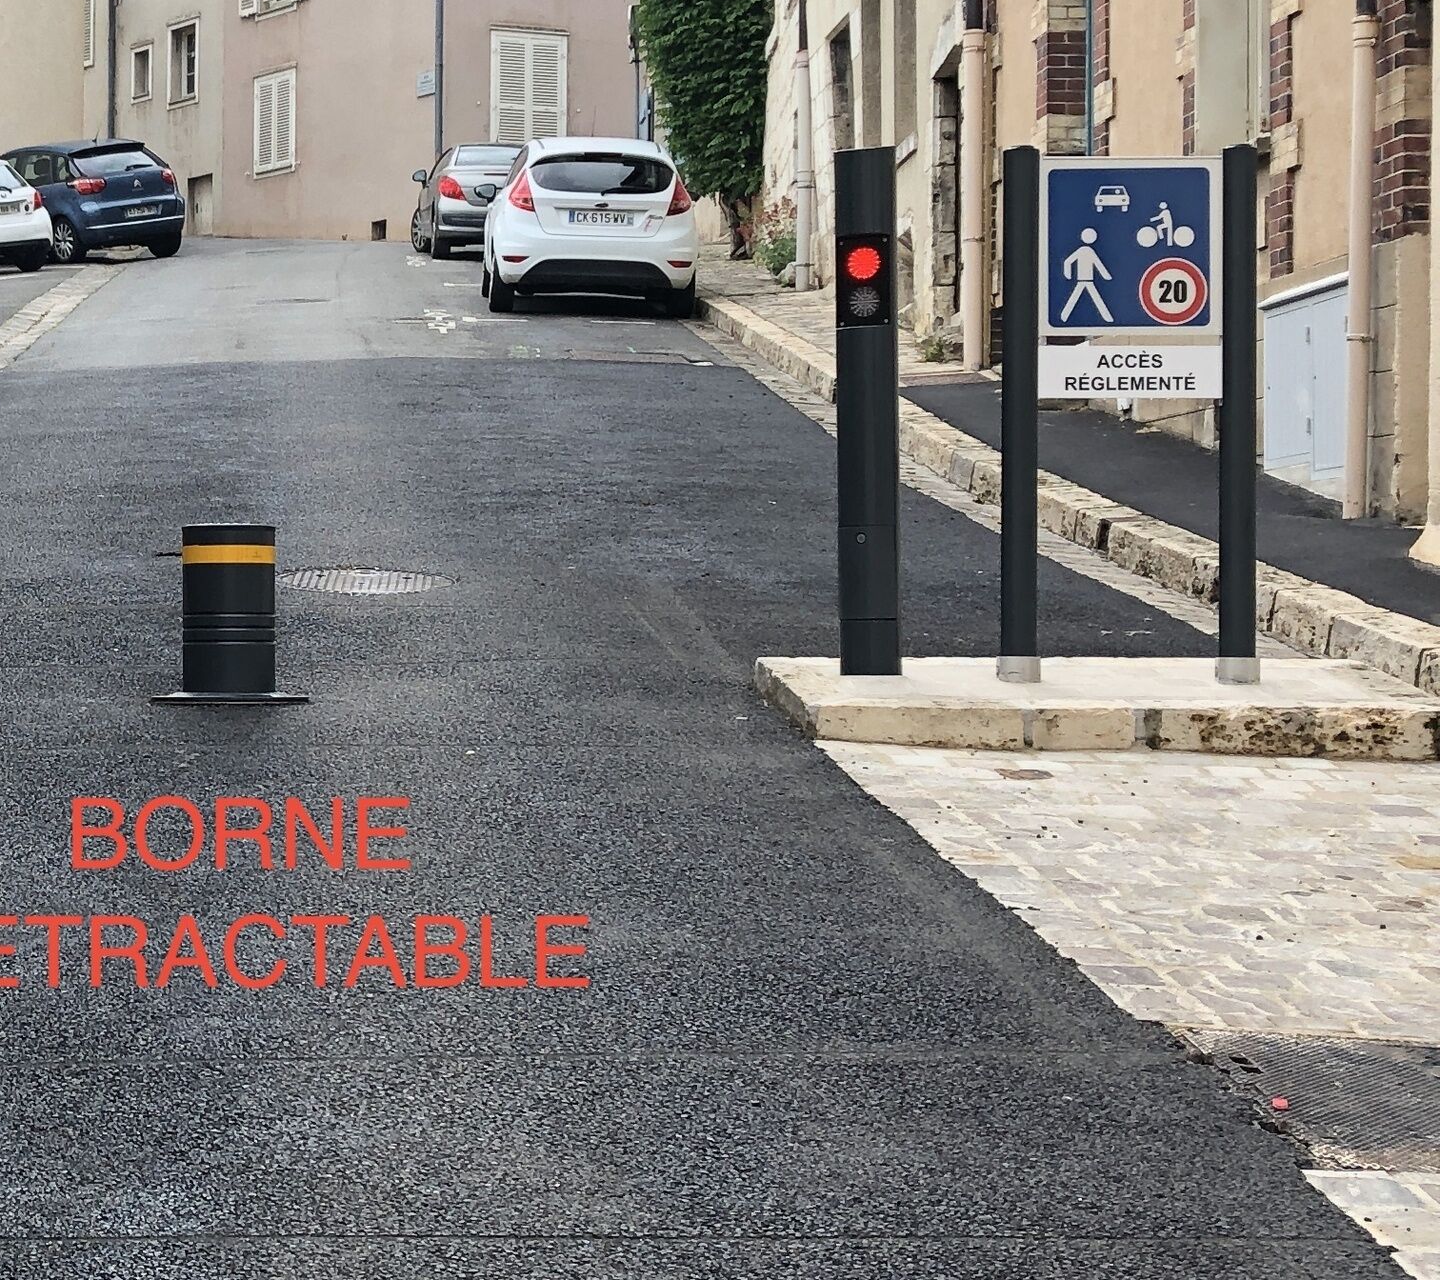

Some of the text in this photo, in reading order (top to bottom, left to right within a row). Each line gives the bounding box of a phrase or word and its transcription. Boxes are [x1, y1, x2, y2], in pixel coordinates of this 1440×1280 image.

[1158, 279, 1188, 304] 20
[1096, 349, 1164, 369] ACCÈS
[1064, 372, 1196, 391] RÉGLEMENTÉ
